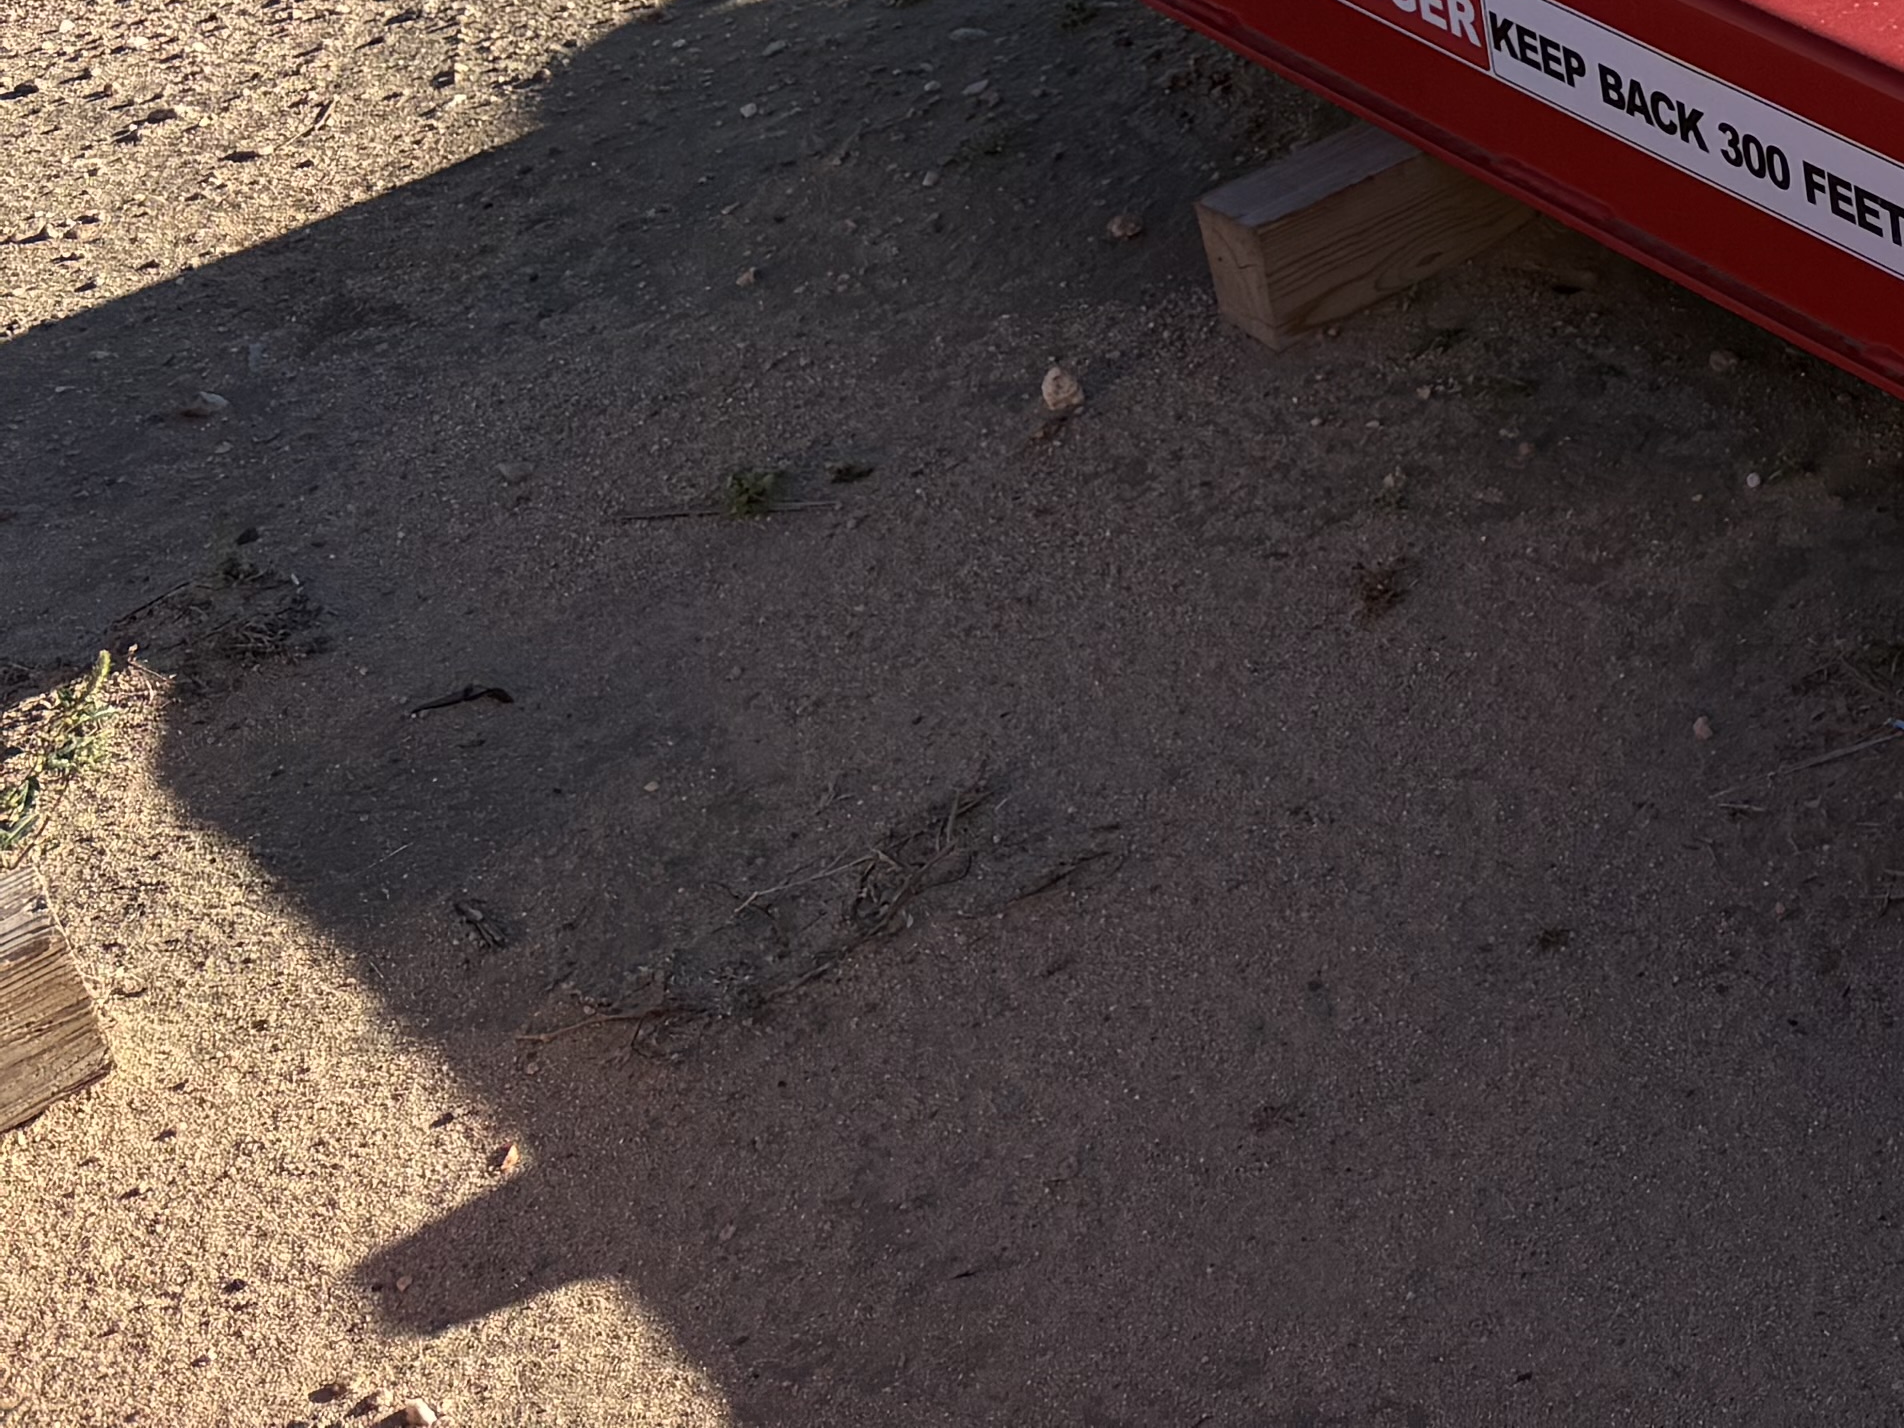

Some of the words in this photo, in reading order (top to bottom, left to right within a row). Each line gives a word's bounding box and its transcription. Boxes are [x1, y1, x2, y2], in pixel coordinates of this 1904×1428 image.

[1488, 9, 1587, 89] KEEP
[1597, 62, 1710, 155] BACK
[1717, 121, 1792, 191] 300
